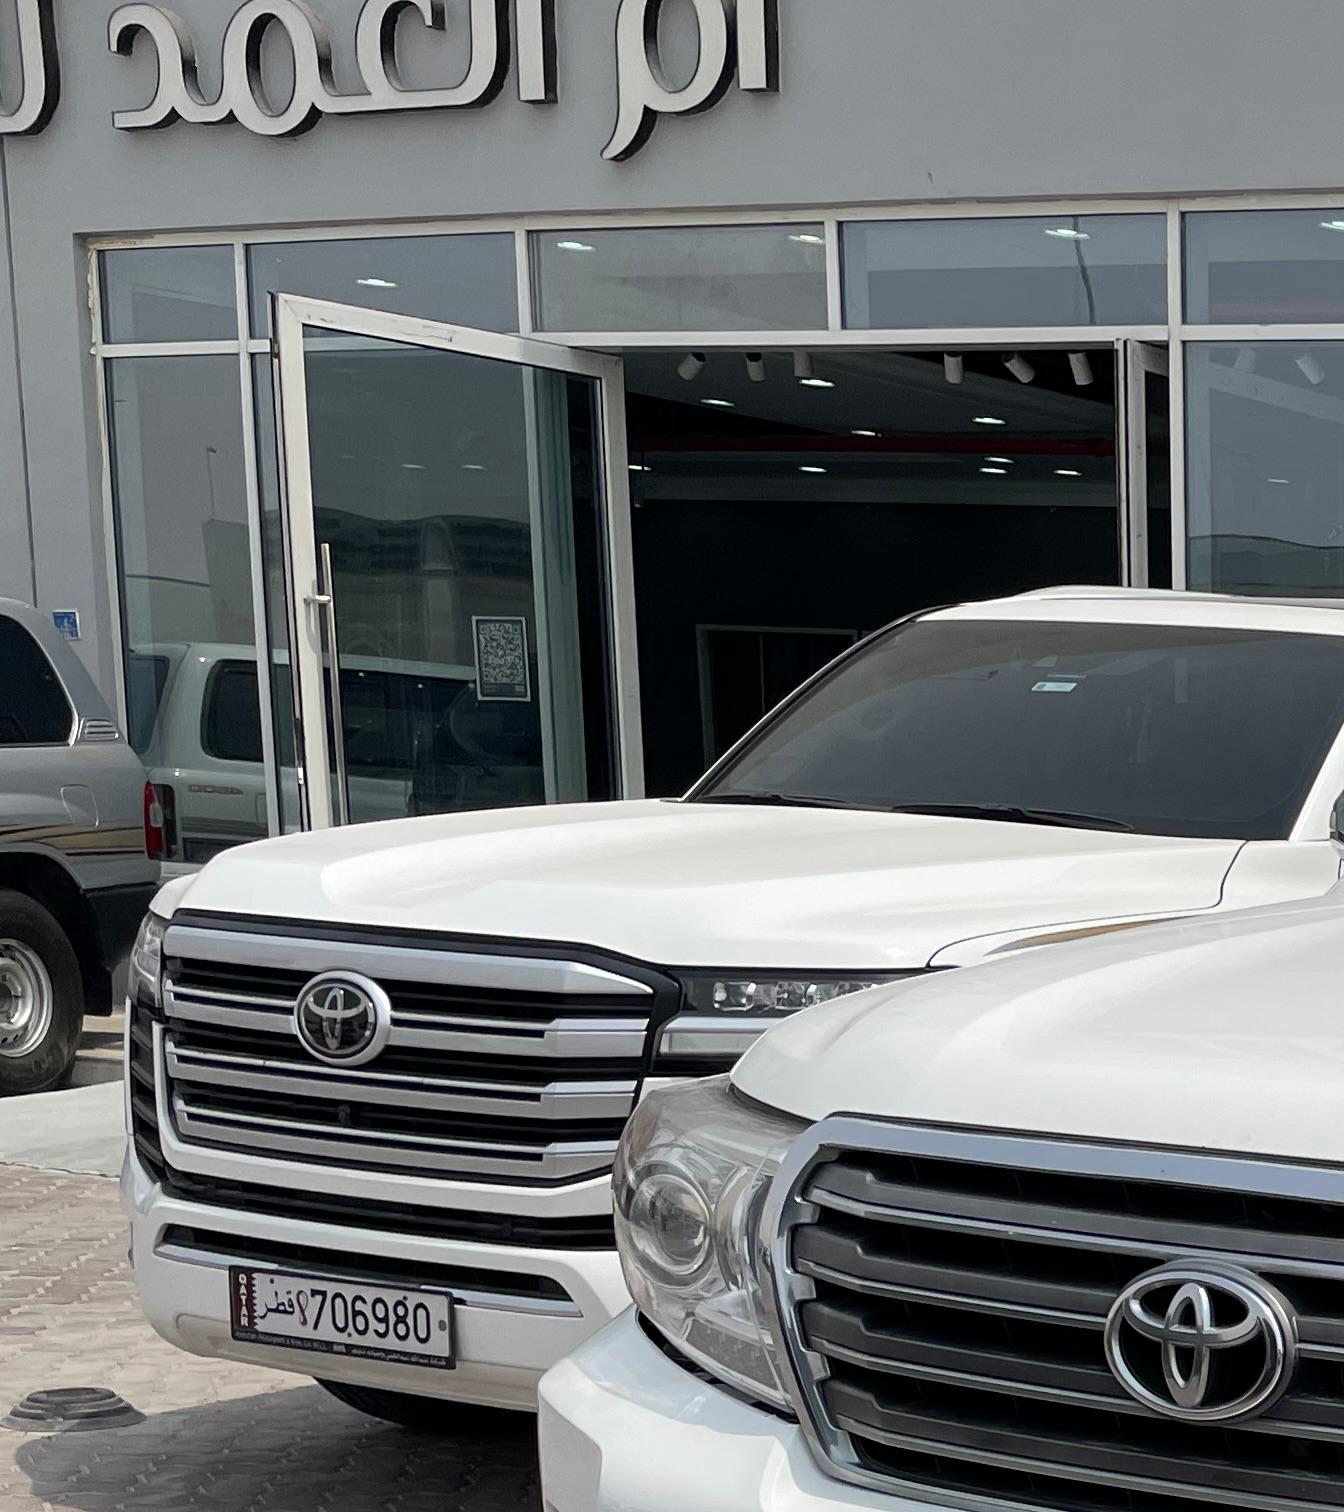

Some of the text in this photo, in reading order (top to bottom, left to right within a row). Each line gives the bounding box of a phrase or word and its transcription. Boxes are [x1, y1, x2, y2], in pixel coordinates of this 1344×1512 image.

[238, 1273, 249, 1327] QATAR
[257, 1289, 295, 1319] قطر
[309, 1288, 431, 1344] 706980
